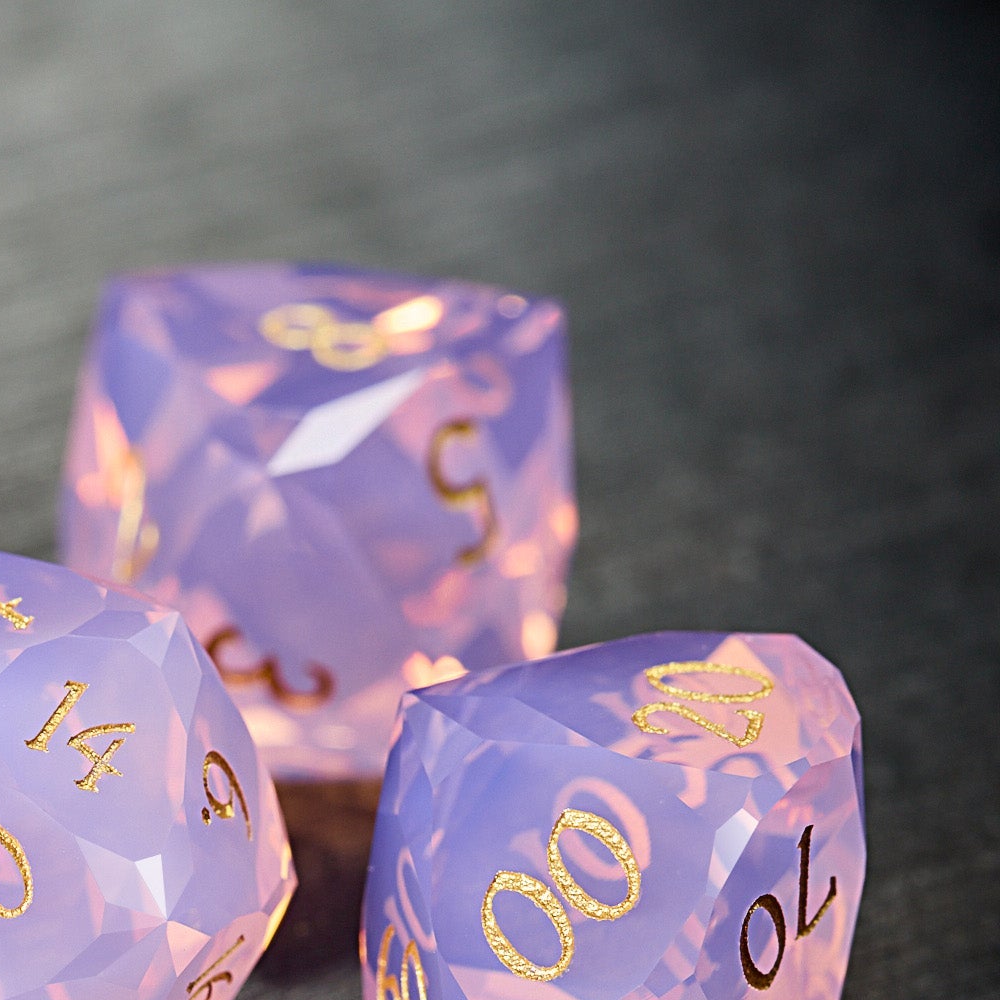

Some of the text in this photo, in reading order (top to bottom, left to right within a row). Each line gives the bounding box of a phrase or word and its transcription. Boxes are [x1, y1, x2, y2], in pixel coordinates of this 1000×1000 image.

[258, 303, 390, 371] 8
[428, 418, 496, 566] 5
[204, 626, 337, 709] 3
[632, 661, 774, 748] 20
[25, 680, 135, 793] 14
[481, 808, 642, 983] 00
